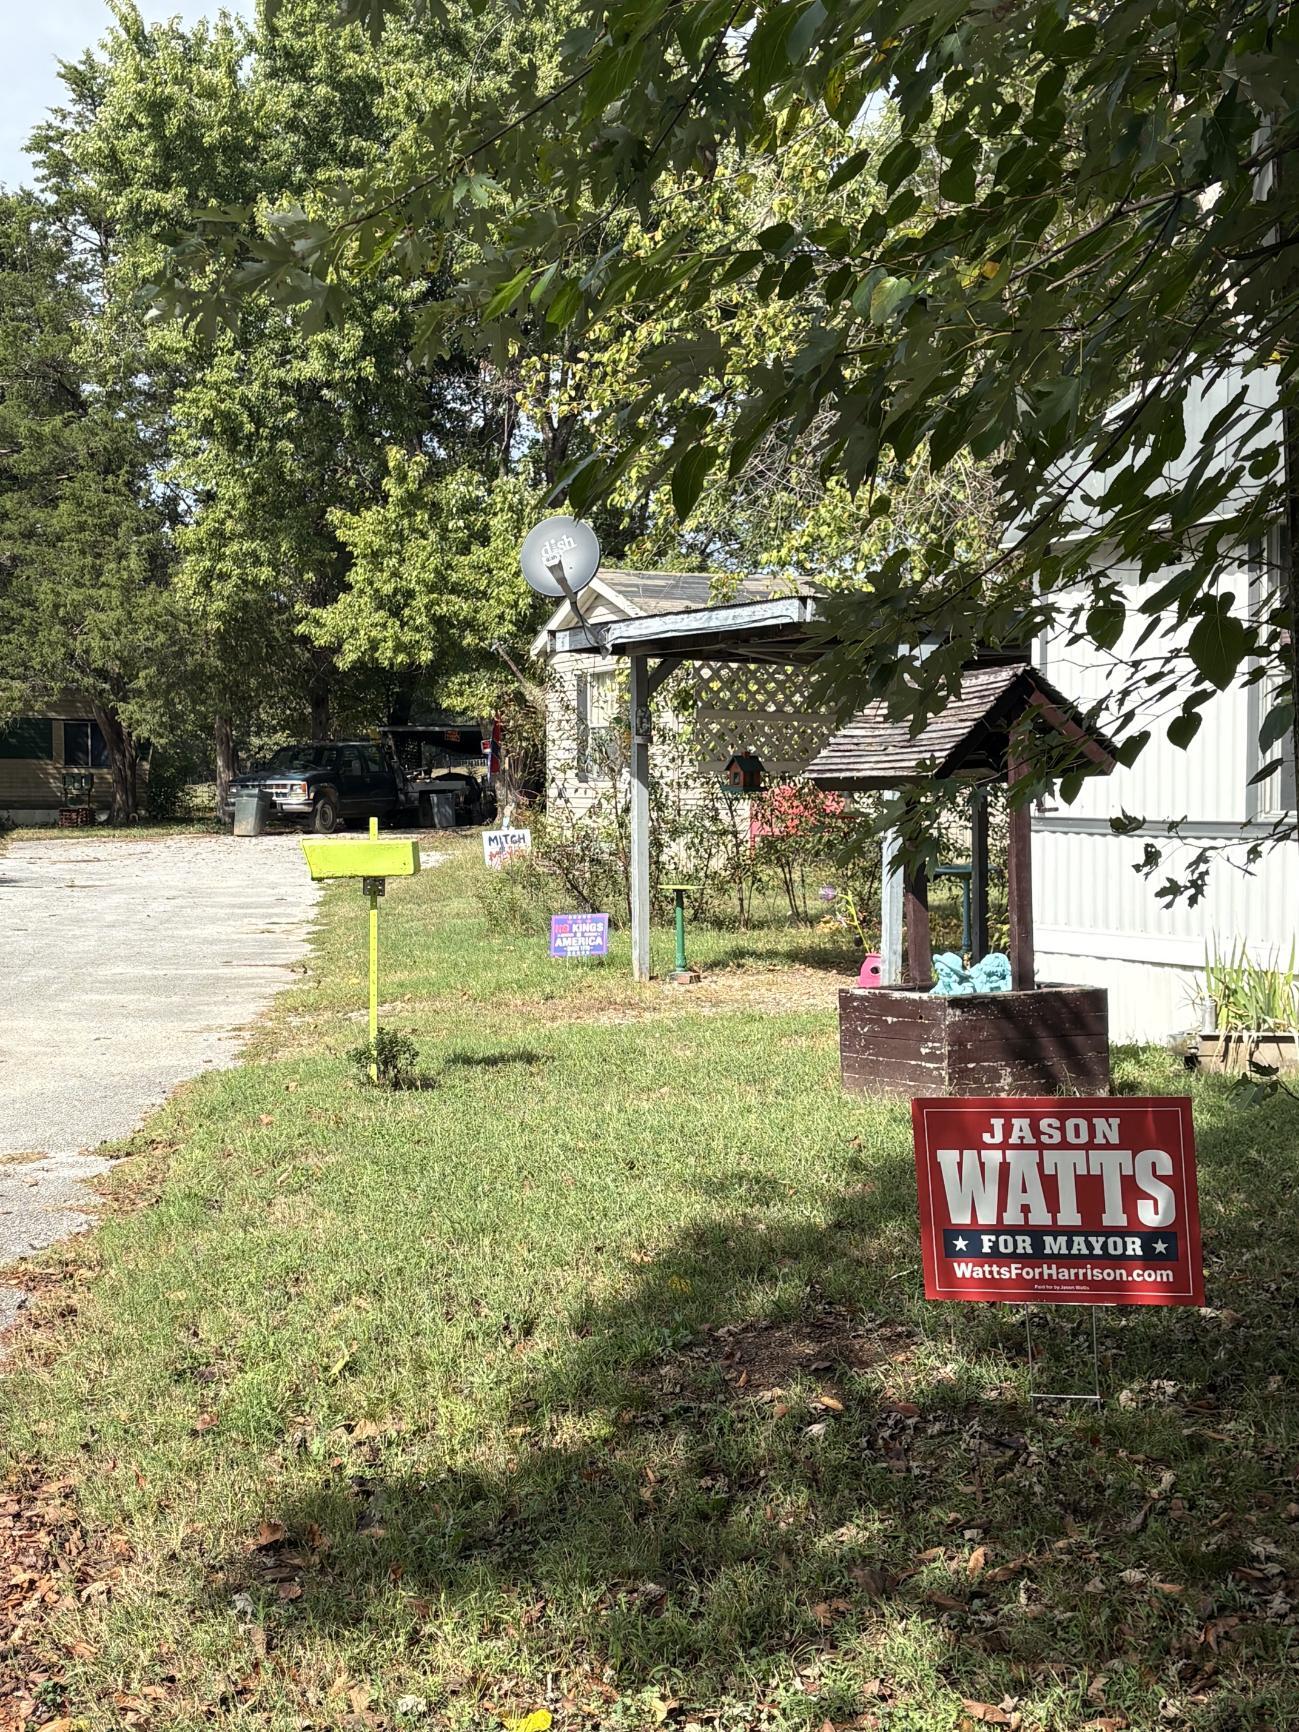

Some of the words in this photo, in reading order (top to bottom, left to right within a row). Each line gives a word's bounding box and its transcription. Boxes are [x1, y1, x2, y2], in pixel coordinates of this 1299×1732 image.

[541, 534, 577, 556] dish
[488, 833, 526, 846] MITCH
[573, 923, 603, 932] KINGS
[555, 936, 602, 946] AMERICA
[982, 1118, 1120, 1144] JASON
[937, 1150, 1176, 1227] WATTS
[981, 1235, 1033, 1254] FOR
[1043, 1236, 1143, 1255] MAYOR
[953, 1262, 1173, 1282] WattsForHarrison.com
